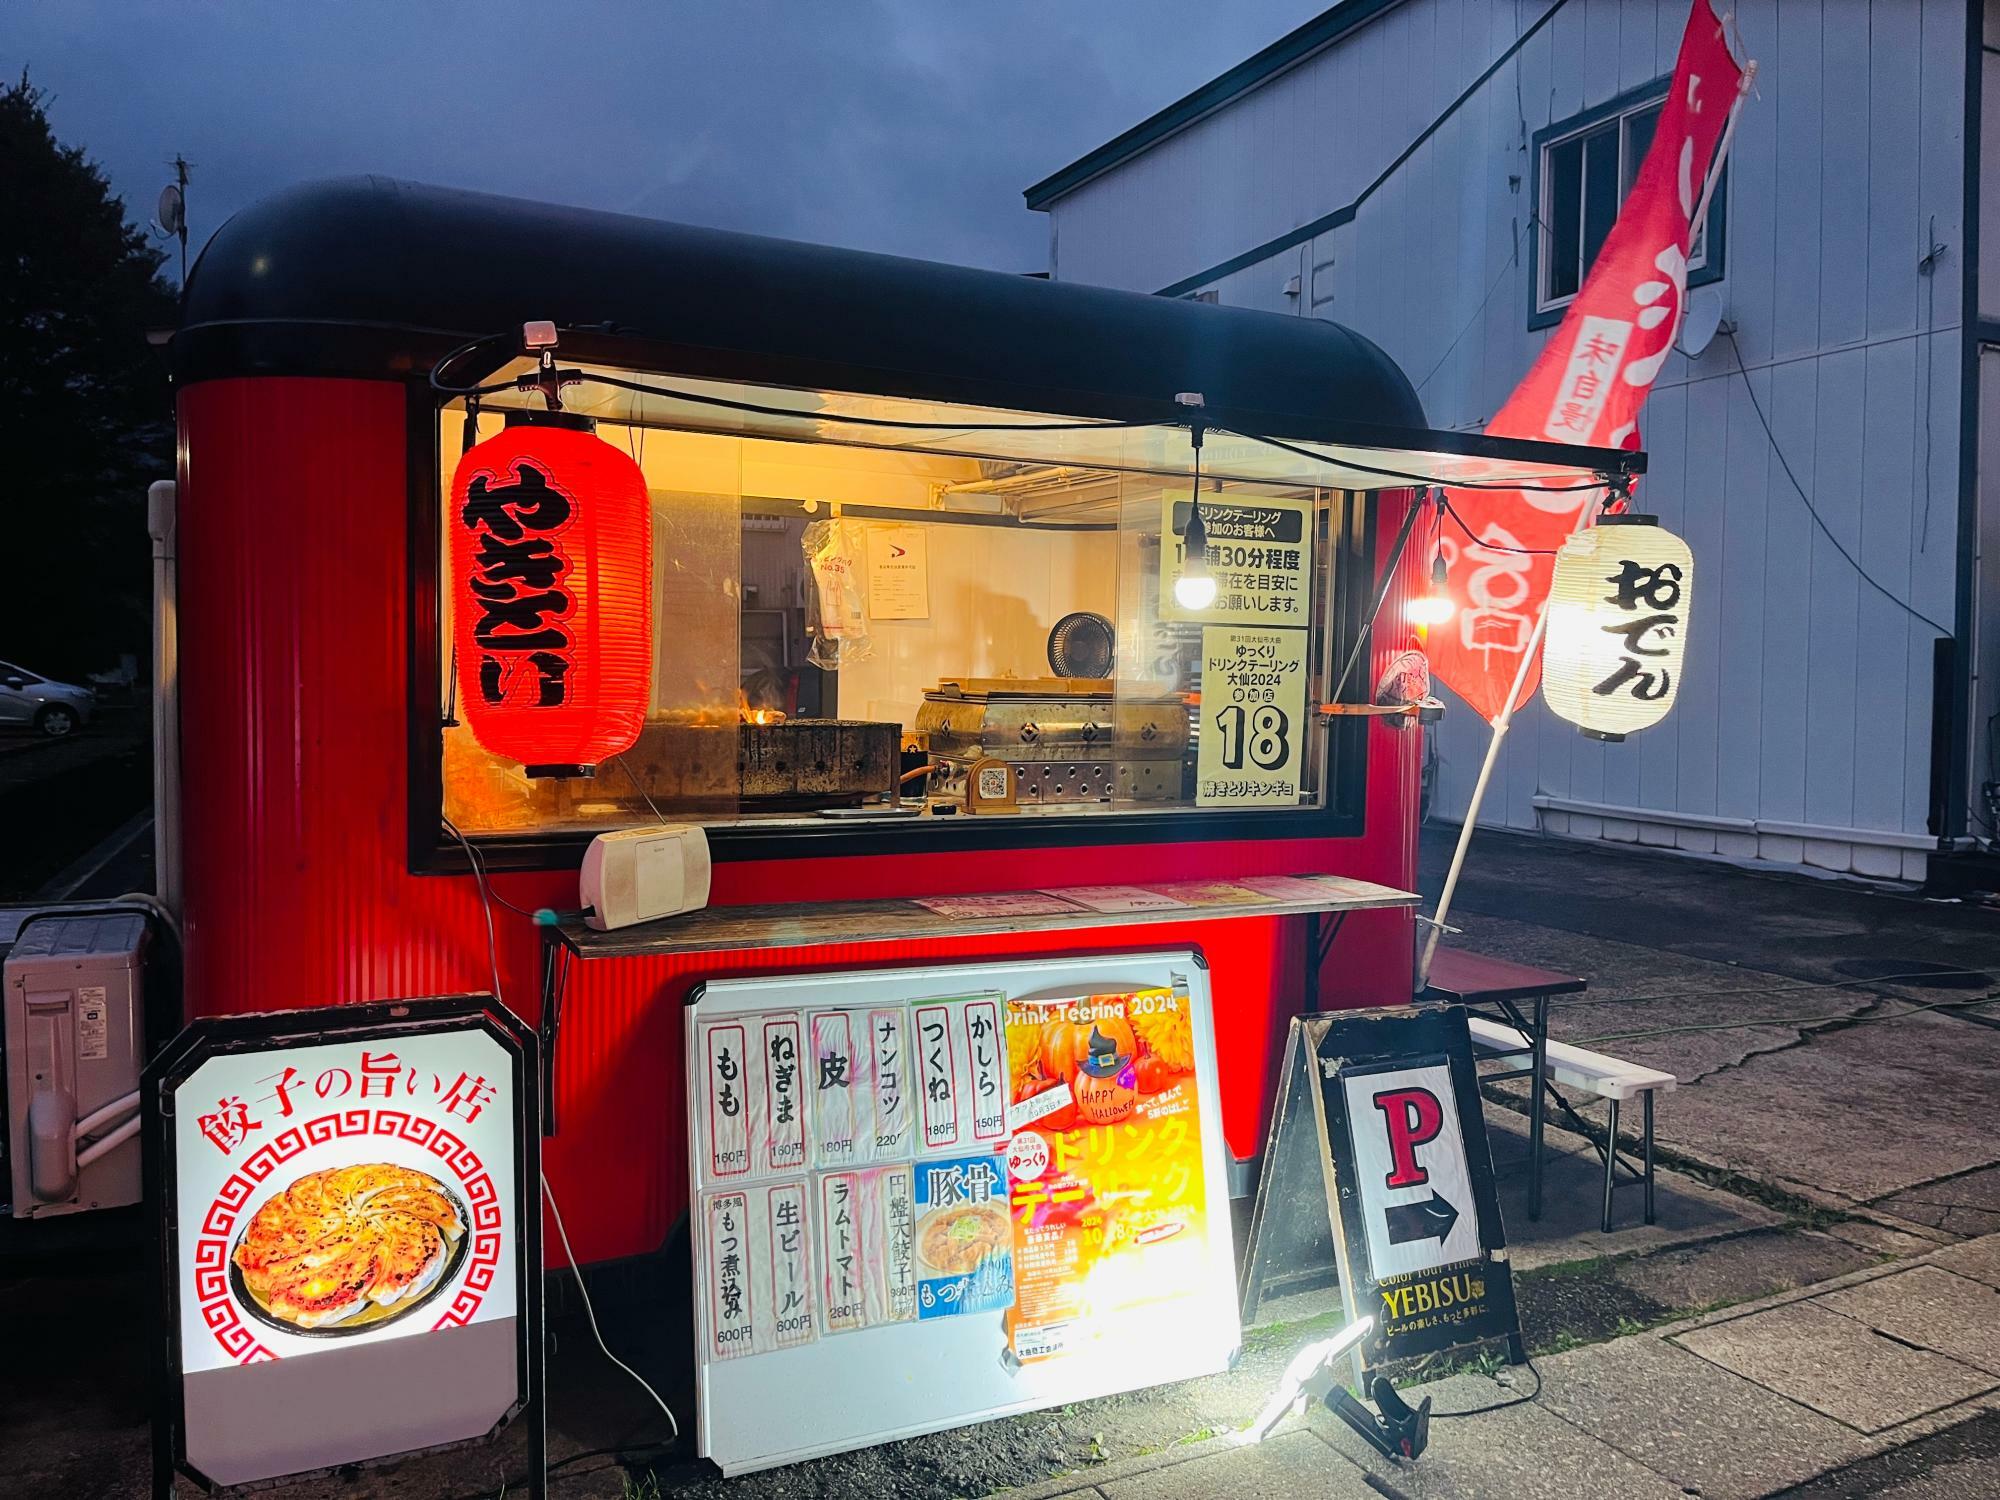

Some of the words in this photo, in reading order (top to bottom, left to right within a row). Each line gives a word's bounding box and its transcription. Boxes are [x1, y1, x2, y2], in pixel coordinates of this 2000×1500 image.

[1175, 543, 1301, 571] 1舗30分程度
[461, 459, 575, 708] やきとり
[1236, 645, 1276, 659] ゆっくり
[1592, 559, 1683, 702] おでん
[1209, 658, 1300, 673] ドリンクテーリング
[1227, 673, 1281, 686] 大仙2024
[1232, 688, 1275, 703] 参加店
[1216, 705, 1290, 771] 18
[1203, 780, 1294, 798] 焼きとりキンギョ
[1057, 1003, 1125, 1022] Teering
[1132, 994, 1179, 1015] 2024
[818, 1051, 850, 1091] 皮
[878, 1021, 900, 1115] ナンコツ
[922, 1023, 951, 1103] つくね
[970, 1014, 996, 1097] かしら
[717, 1047, 740, 1117] もも
[770, 1034, 796, 1124] ねぎま
[1081, 1088, 1116, 1105] HAPPY
[196, 1051, 498, 1155] 餃子の旨い店
[976, 1115, 1003, 1128] 150円
[877, 1133, 901, 1148] 220
[927, 1122, 955, 1136] 180円
[1055, 1116, 1188, 1173] ドリンク
[1373, 1086, 1444, 1190] P
[1009, 1151, 1046, 1169] ゆっくり
[928, 1165, 998, 1208] 豚骨
[776, 1200, 804, 1314] 生ビール
[833, 1183, 853, 1297] ラムトマト
[720, 1212, 743, 1320] もつ煮込み
[1381, 1273, 1472, 1320] YEBISU
[717, 1325, 752, 1343] 600円
[776, 1314, 812, 1333] 600円
